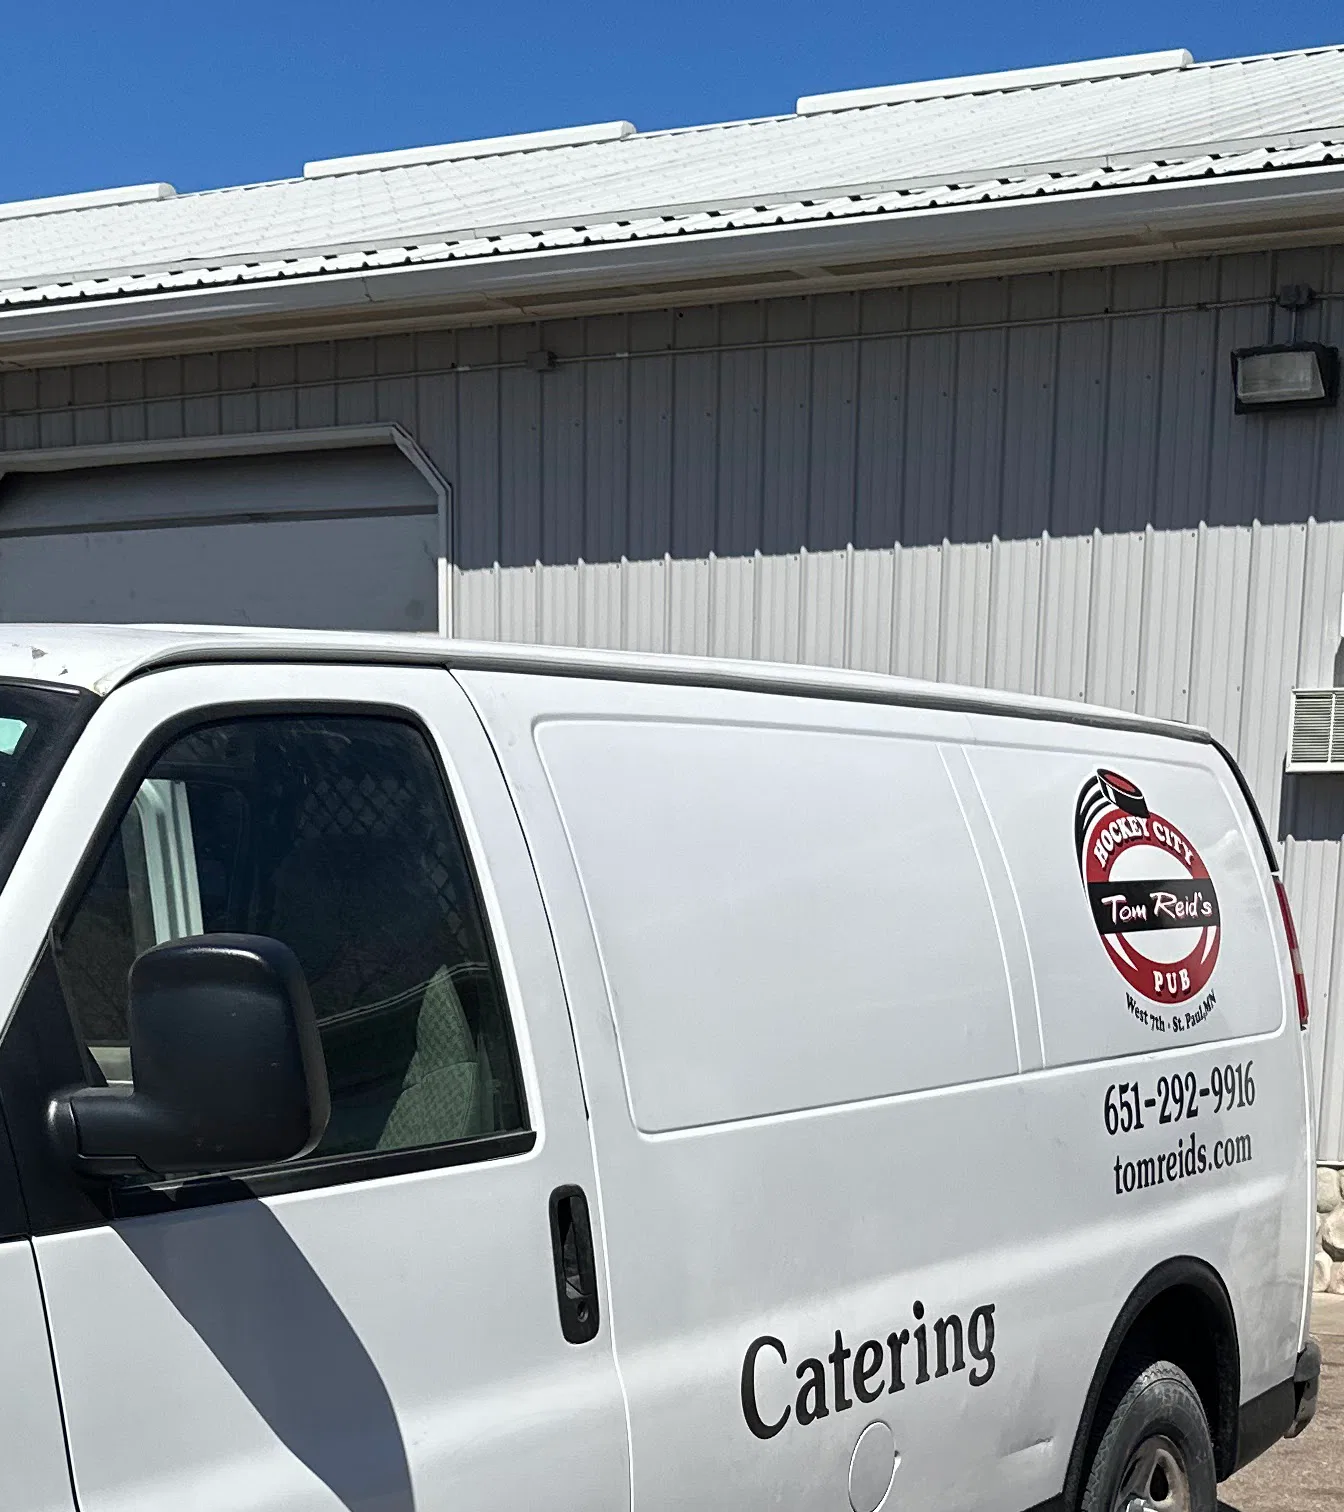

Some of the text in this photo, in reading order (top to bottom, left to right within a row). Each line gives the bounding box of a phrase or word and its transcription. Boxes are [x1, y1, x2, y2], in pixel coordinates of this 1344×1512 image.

[1093, 815, 1194, 871] HOCKEY CITY
[1101, 891, 1213, 925] Tom Reid's
[1152, 967, 1192, 997] PUB
[1125, 991, 1149, 1025] West
[1149, 1013, 1166, 1032] 7th
[1172, 1015, 1185, 1033] St.
[1103, 1059, 1256, 1136] 651-292-9916
[1113, 1131, 1253, 1195] tomreids.com
[741, 1300, 997, 1440] Catering
